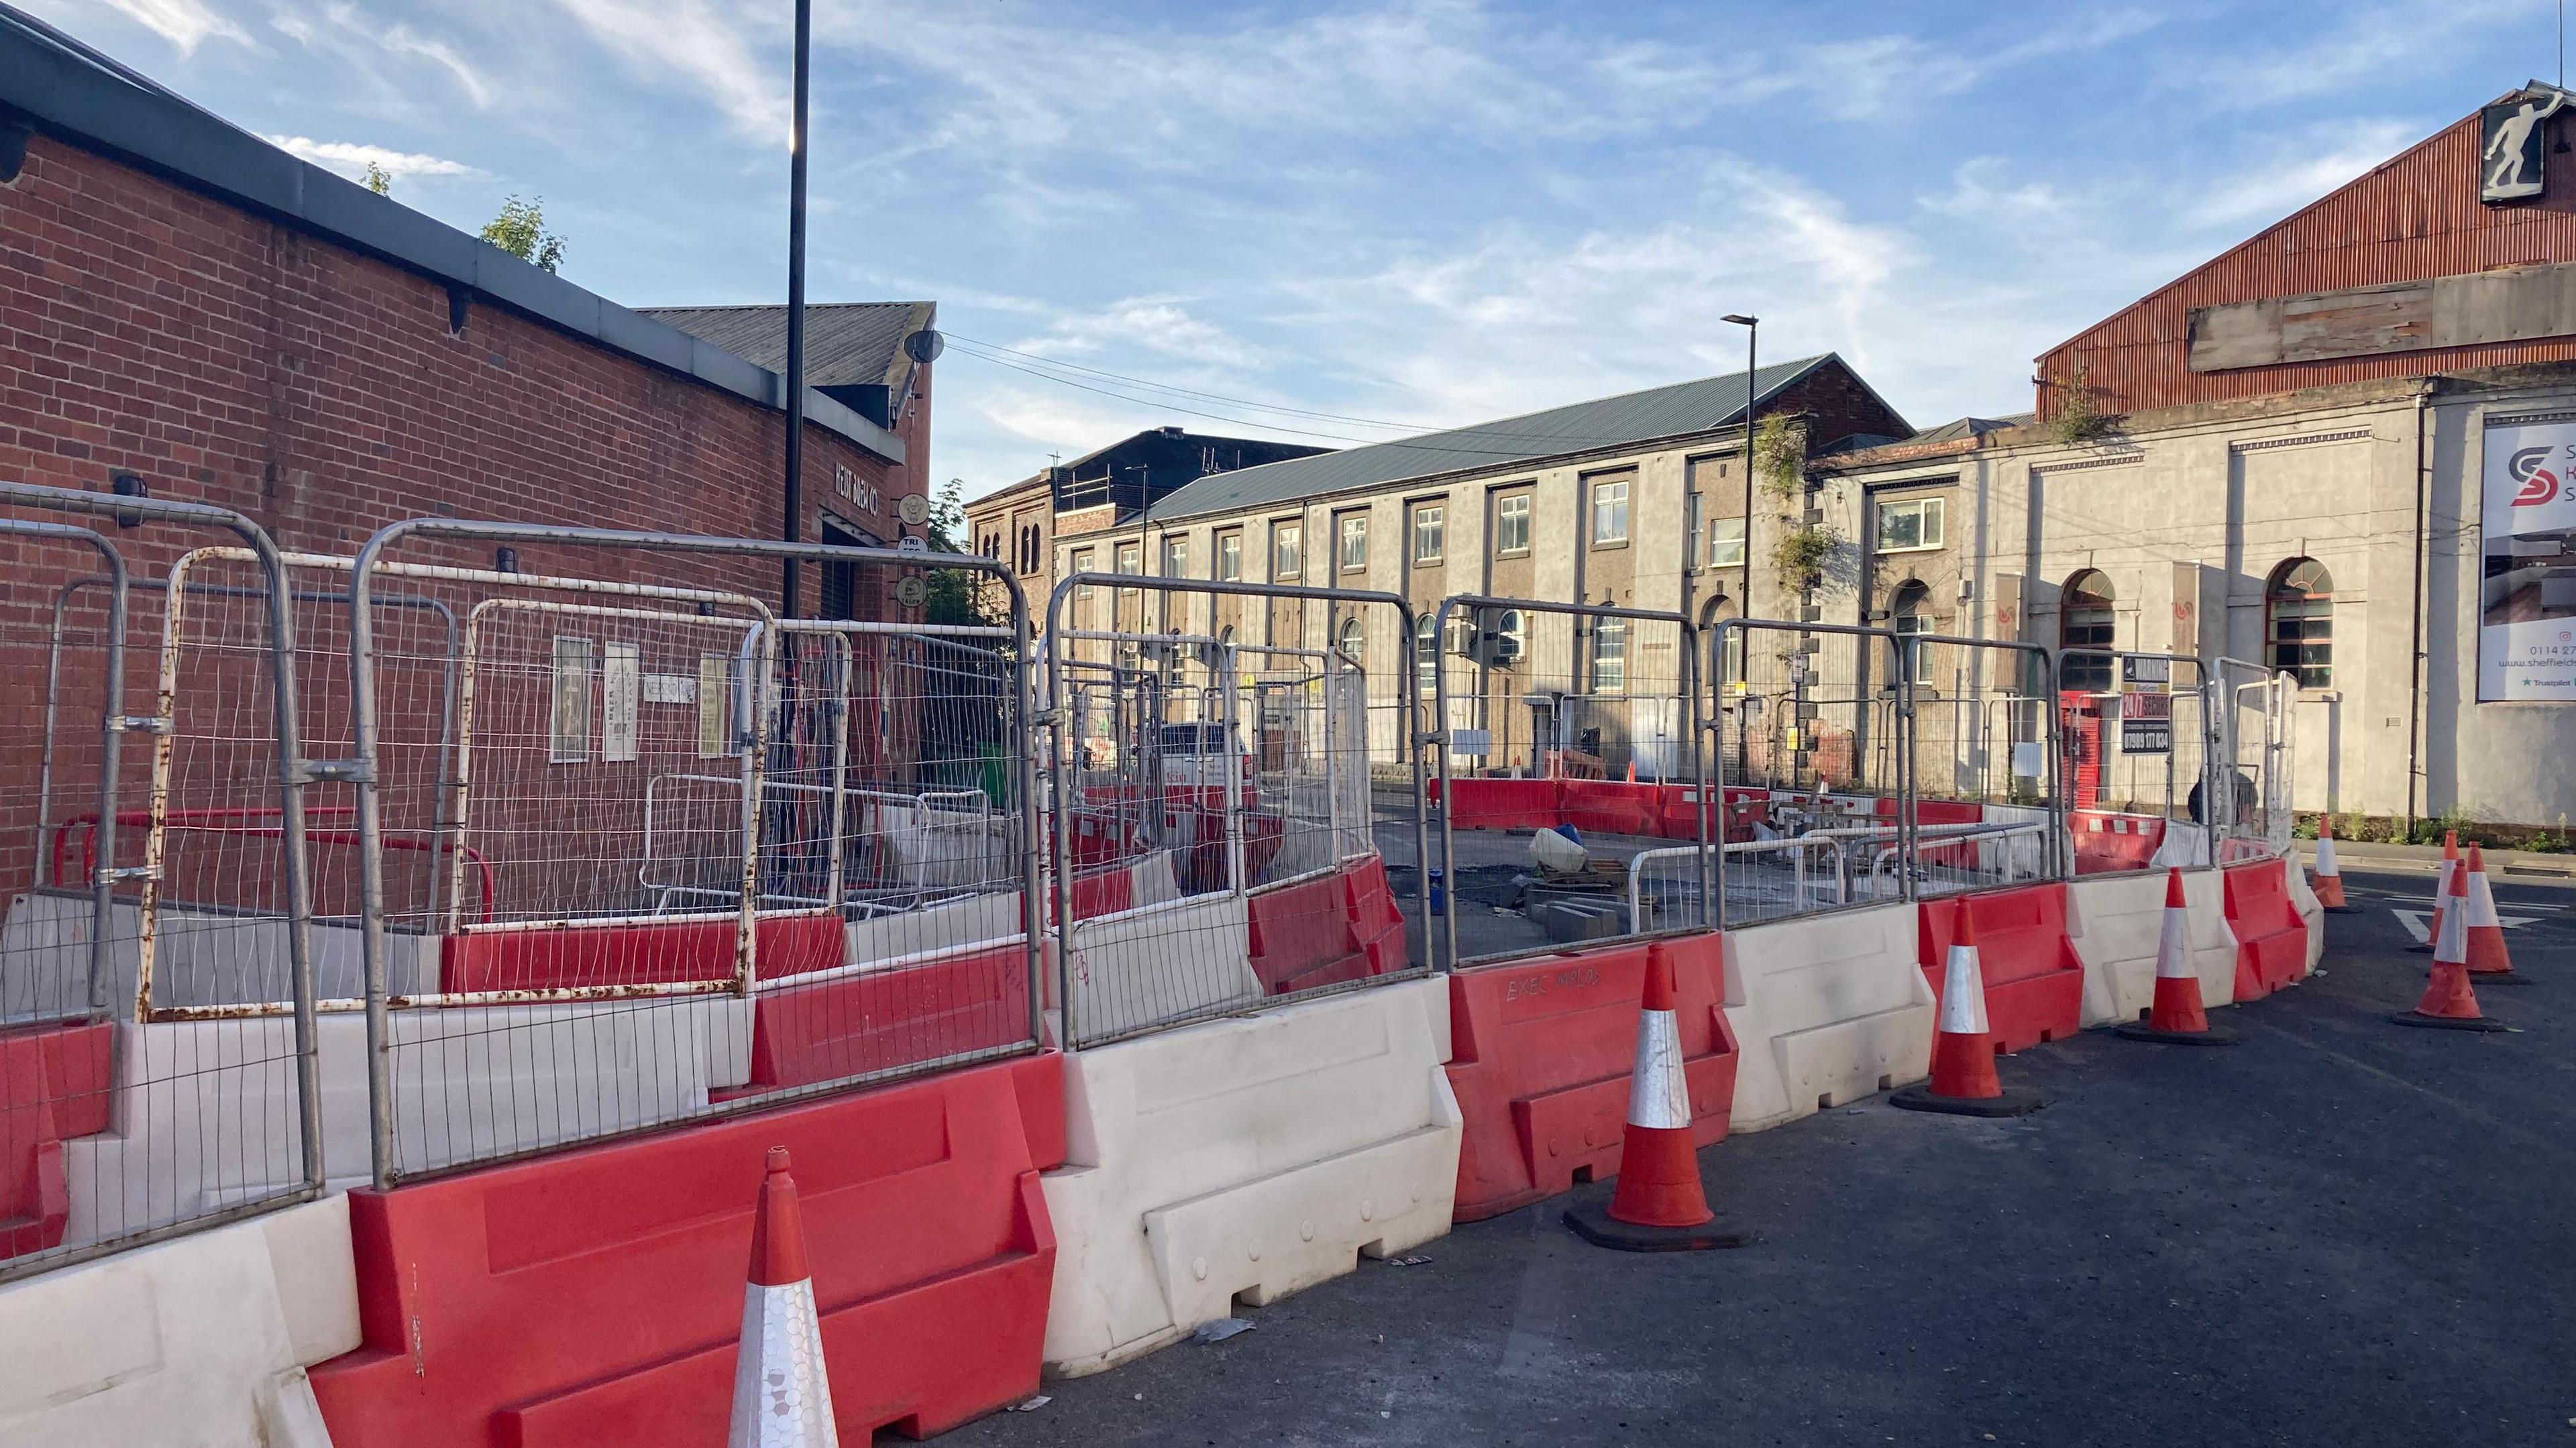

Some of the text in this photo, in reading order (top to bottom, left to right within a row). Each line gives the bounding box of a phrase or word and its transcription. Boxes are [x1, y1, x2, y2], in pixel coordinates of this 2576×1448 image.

[836, 461, 851, 500] HEIST
[2530, 647, 2558, 655] 0114
[2135, 658, 2168, 681] WARNING
[2125, 693, 2169, 718] 24/7 SECURE
[1507, 975, 1548, 1002] EXEC
